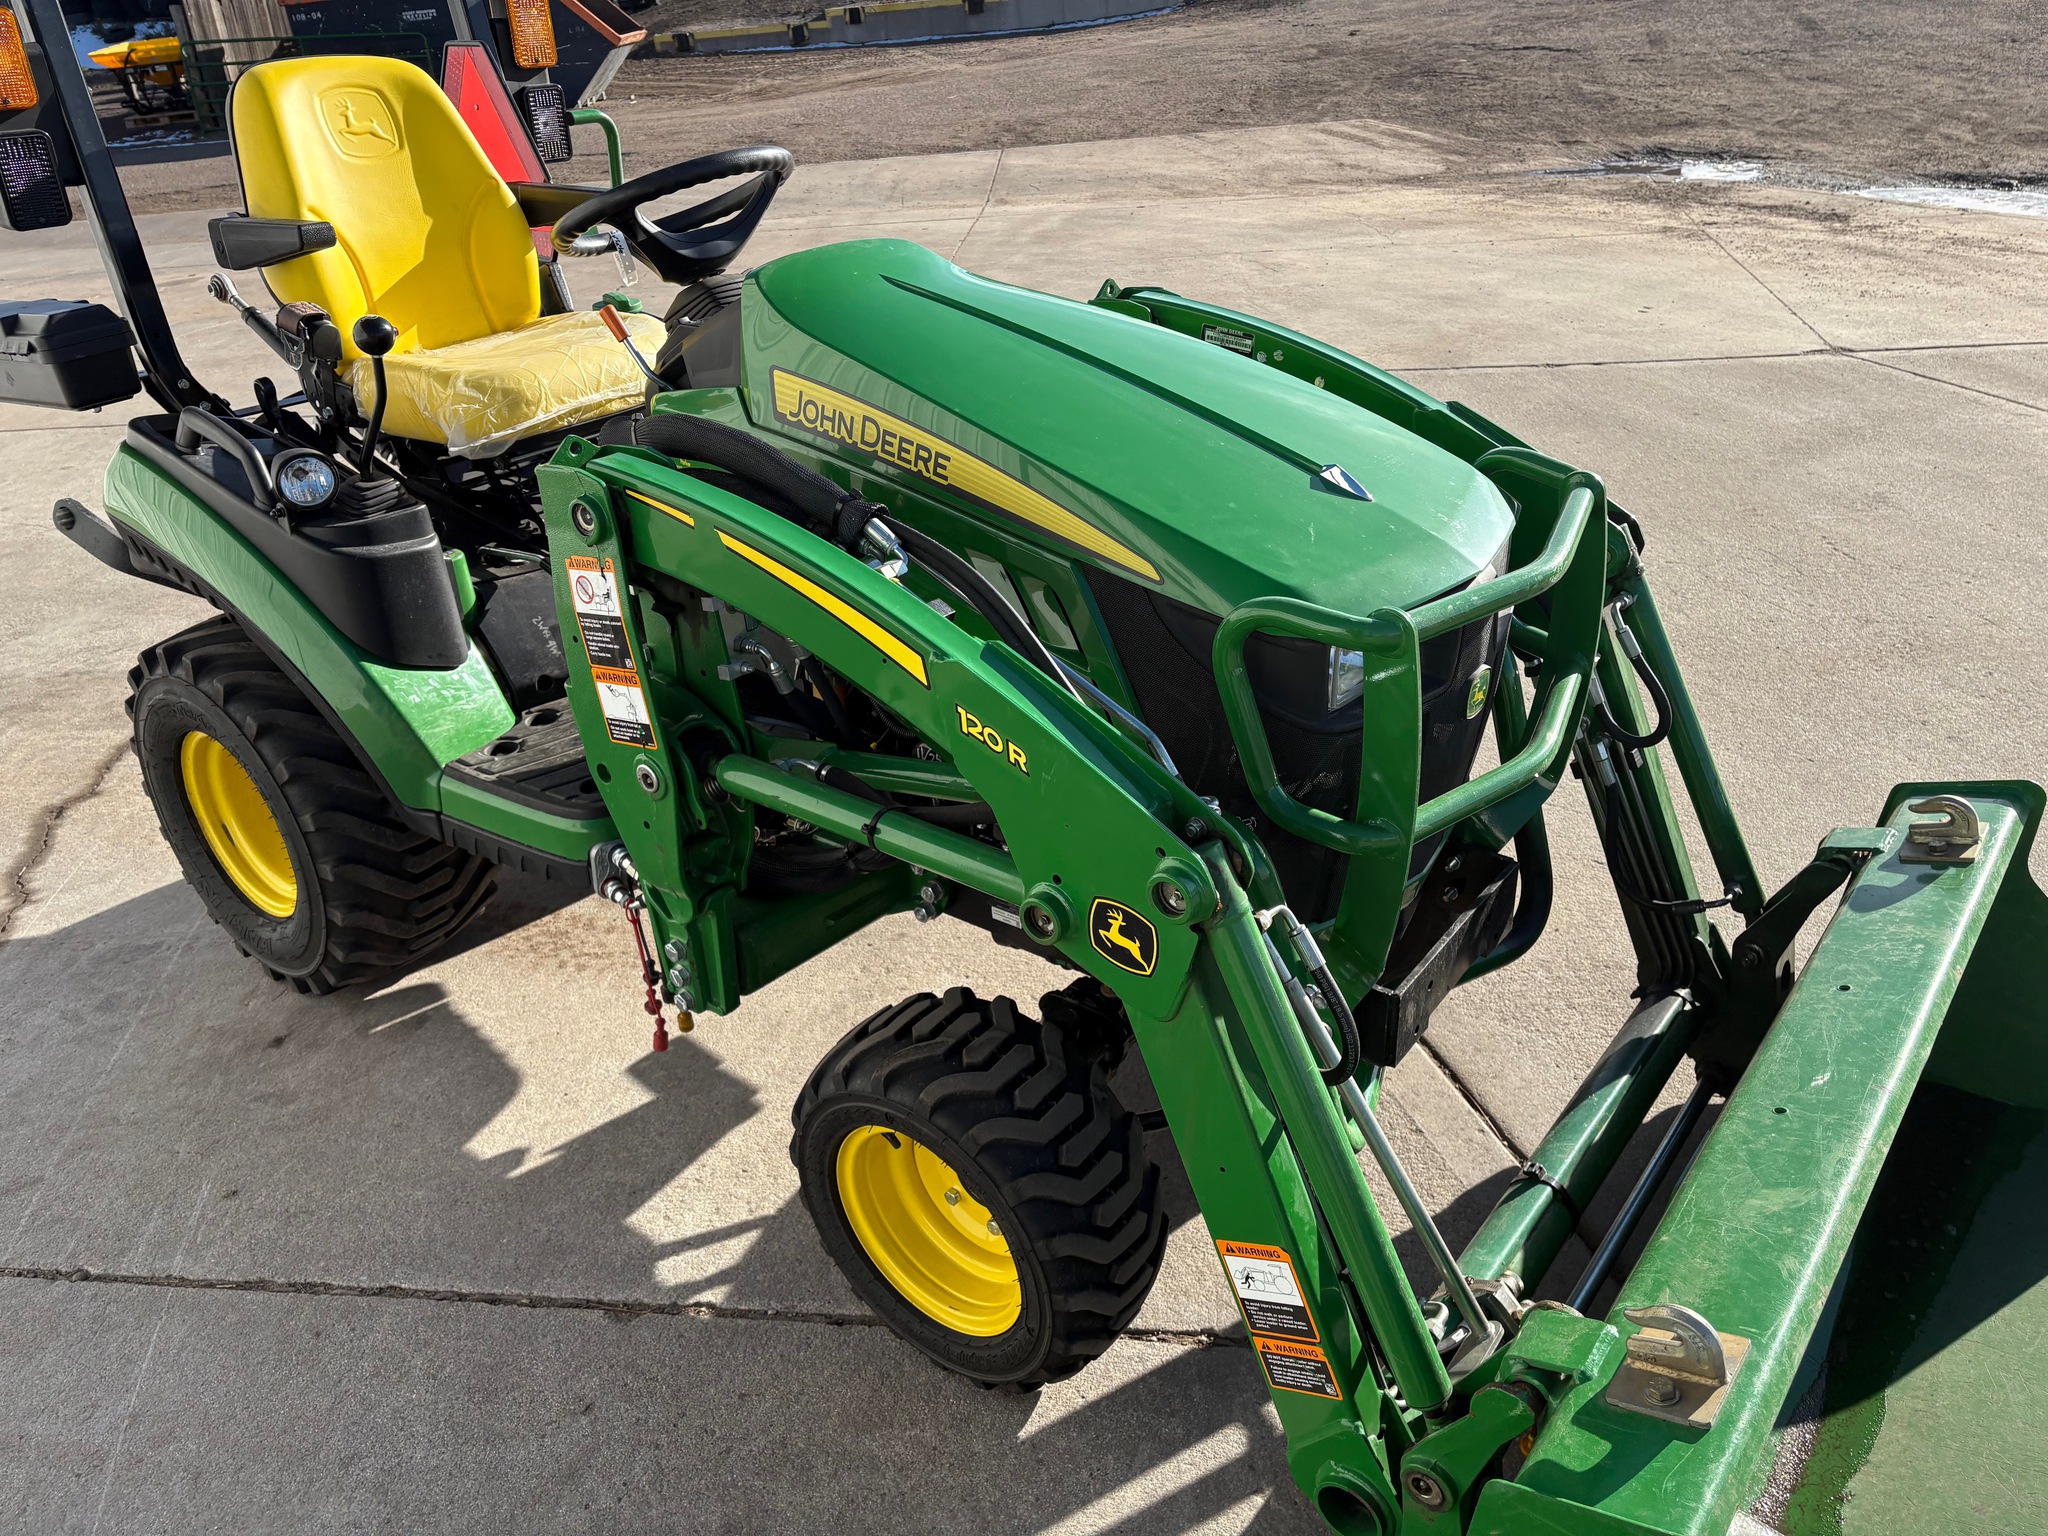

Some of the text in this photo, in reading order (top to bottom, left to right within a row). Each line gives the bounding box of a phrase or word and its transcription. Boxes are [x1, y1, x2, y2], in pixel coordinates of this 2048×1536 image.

[788, 390, 951, 482] JOHN DEERE
[600, 671, 638, 685] WARNING
[956, 705, 1004, 753] 120
[1008, 740, 1028, 774] R
[1235, 1246, 1281, 1259] WARNING
[1273, 1343, 1319, 1358] WARNING
